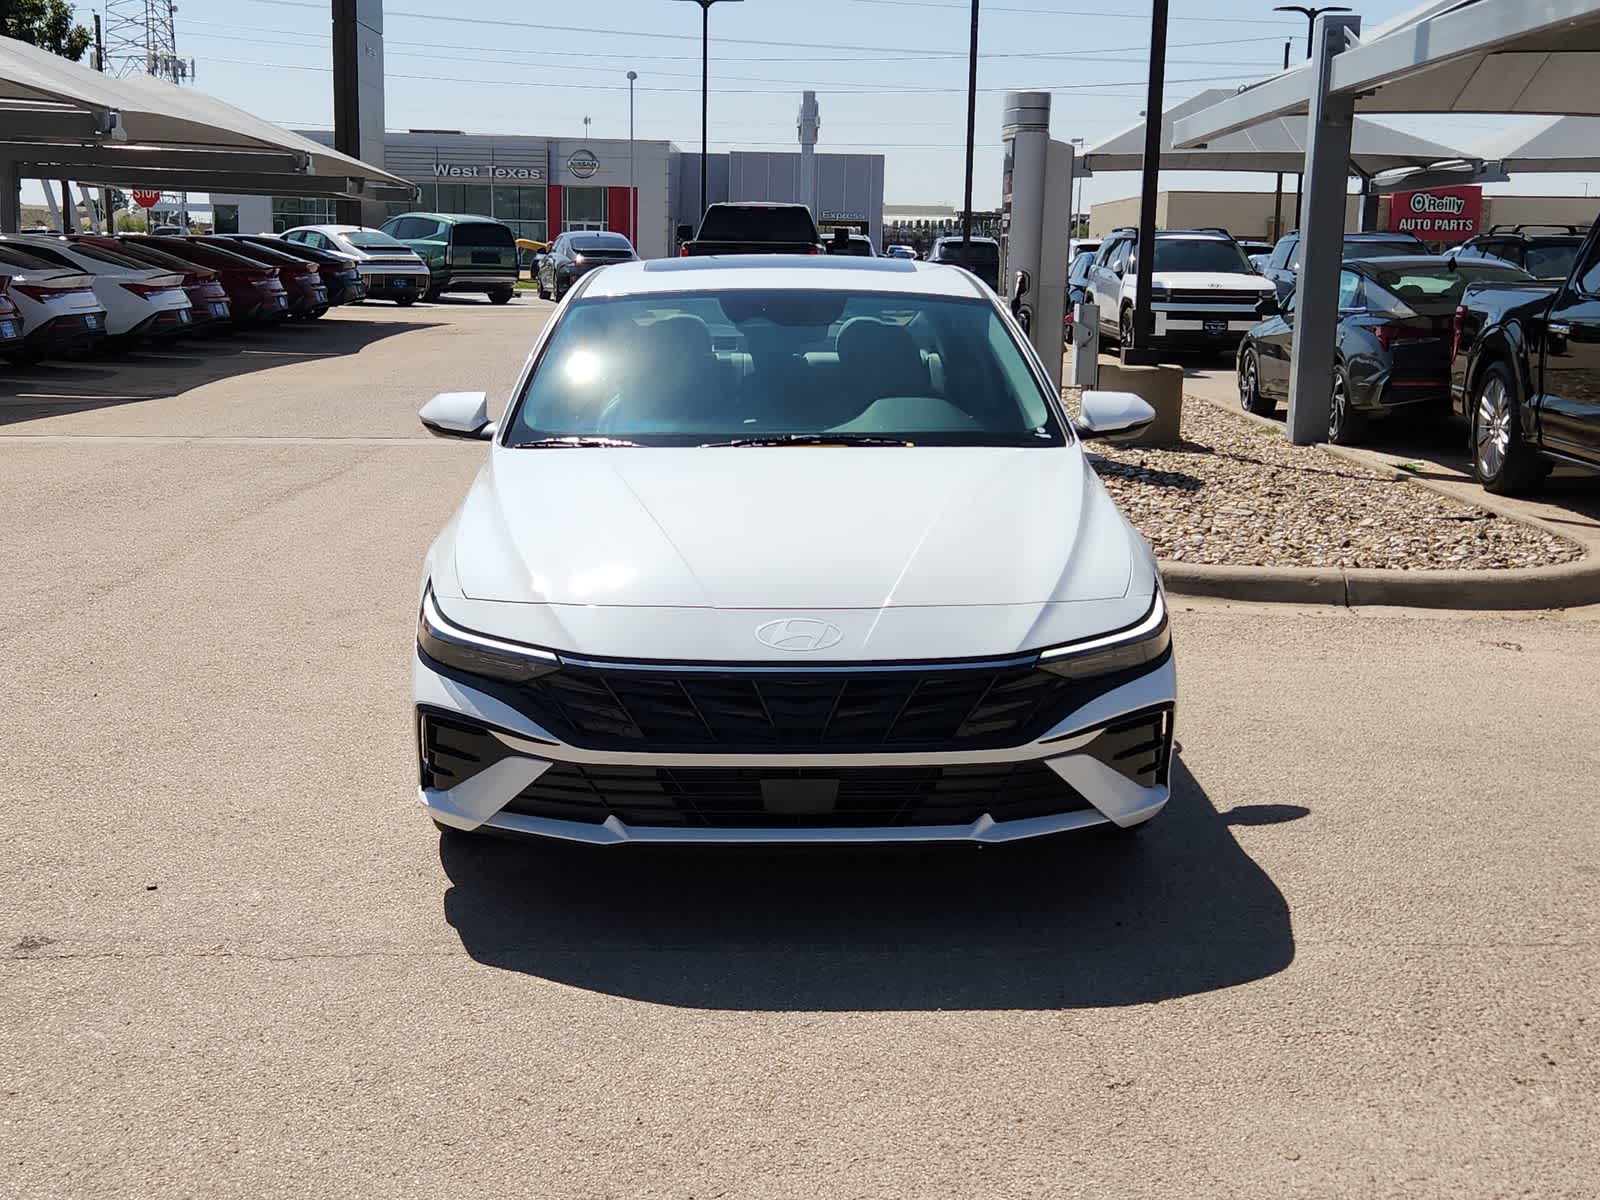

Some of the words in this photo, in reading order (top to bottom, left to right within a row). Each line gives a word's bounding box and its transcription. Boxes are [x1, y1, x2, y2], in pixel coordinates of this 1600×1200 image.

[433, 164, 479, 178] West
[486, 166, 541, 180] Texas
[1411, 193, 1464, 214] O'Reilly
[1399, 218, 1431, 231] AUTO
[1434, 219, 1473, 231] PARTS
